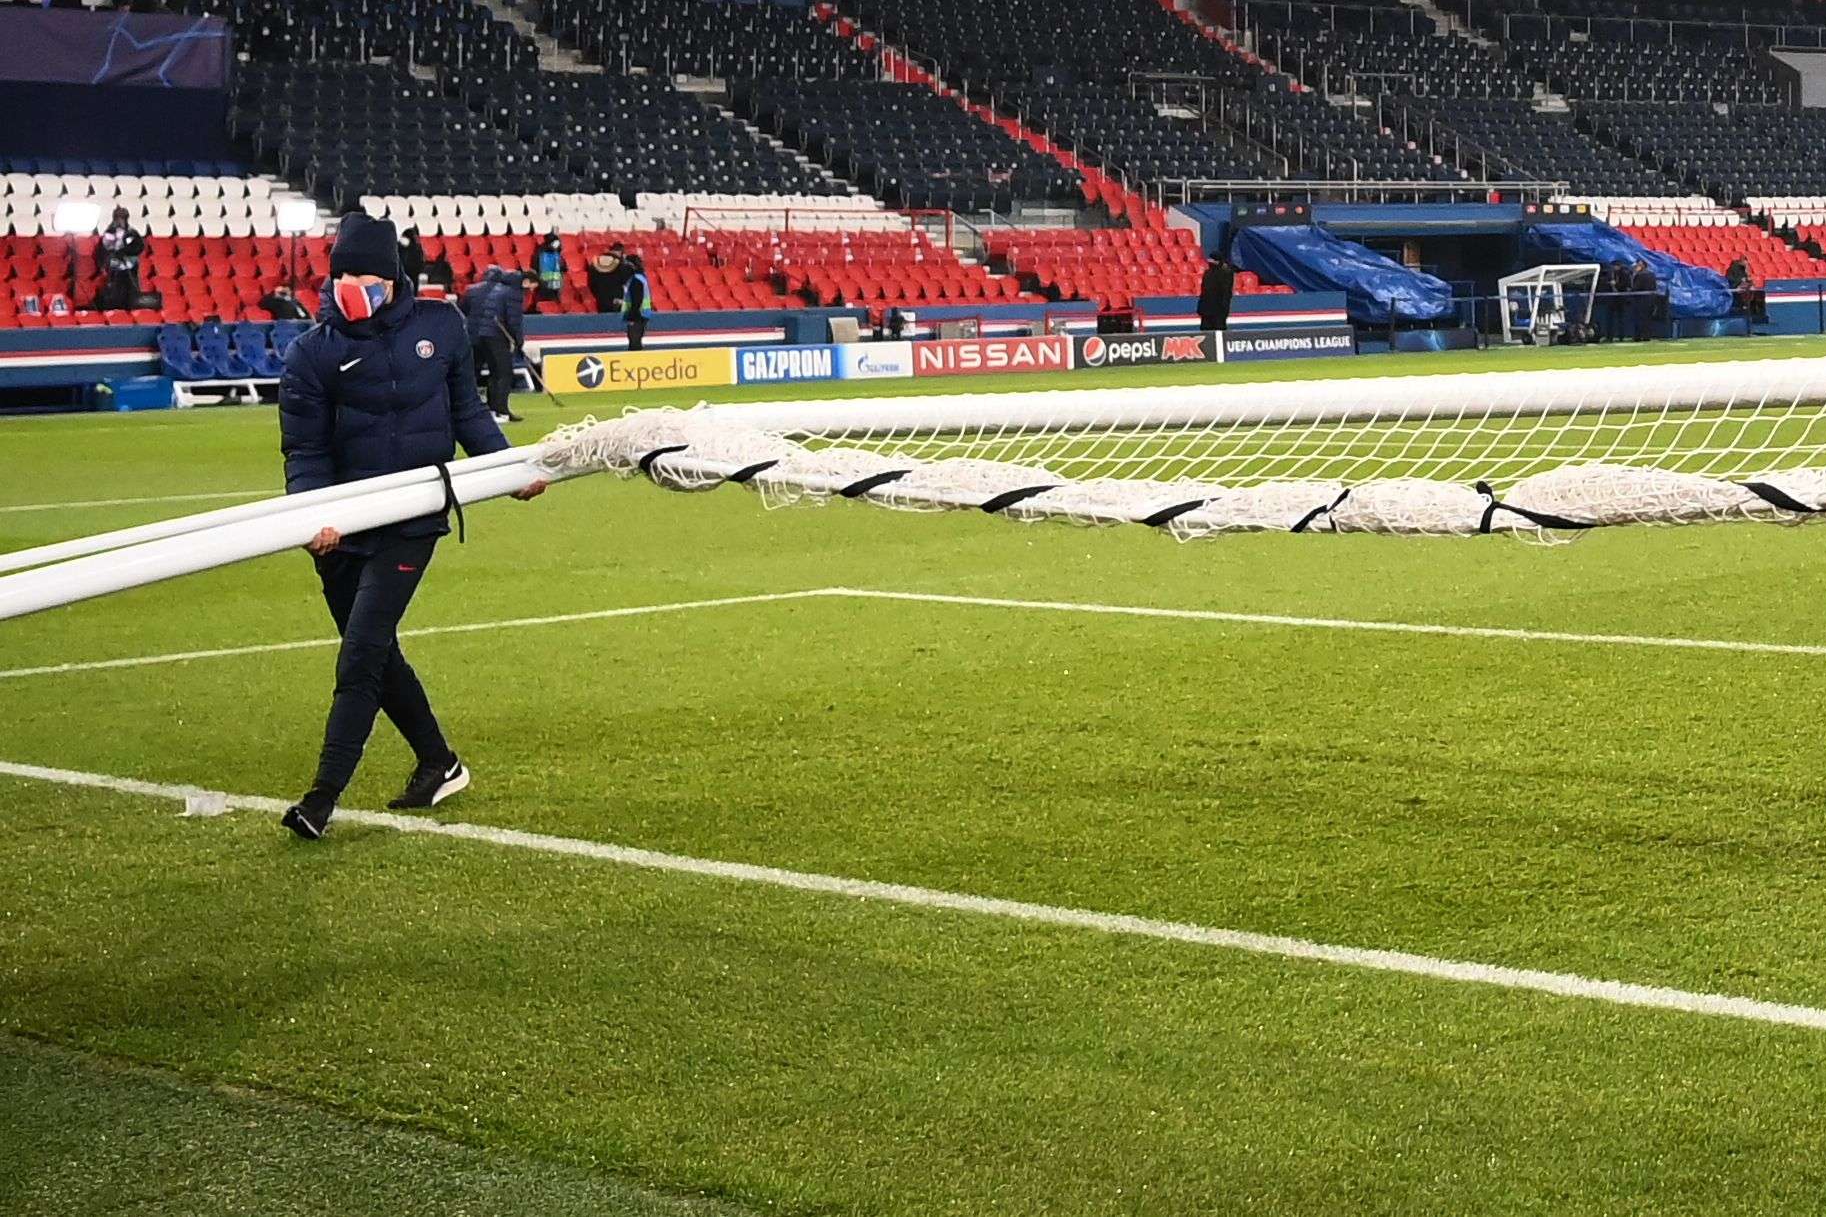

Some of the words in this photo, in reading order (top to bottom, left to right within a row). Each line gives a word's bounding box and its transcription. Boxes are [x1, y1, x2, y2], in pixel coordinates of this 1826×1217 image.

[919, 341, 1061, 370] NISSAN
[1108, 338, 1157, 364] pepsi
[1226, 340, 1253, 353] UEFA
[1255, 338, 1312, 352] CHAMPIONS
[1314, 335, 1351, 349] LEAGUE
[609, 359, 698, 391] Expedia
[742, 349, 832, 380] GAZPROM
